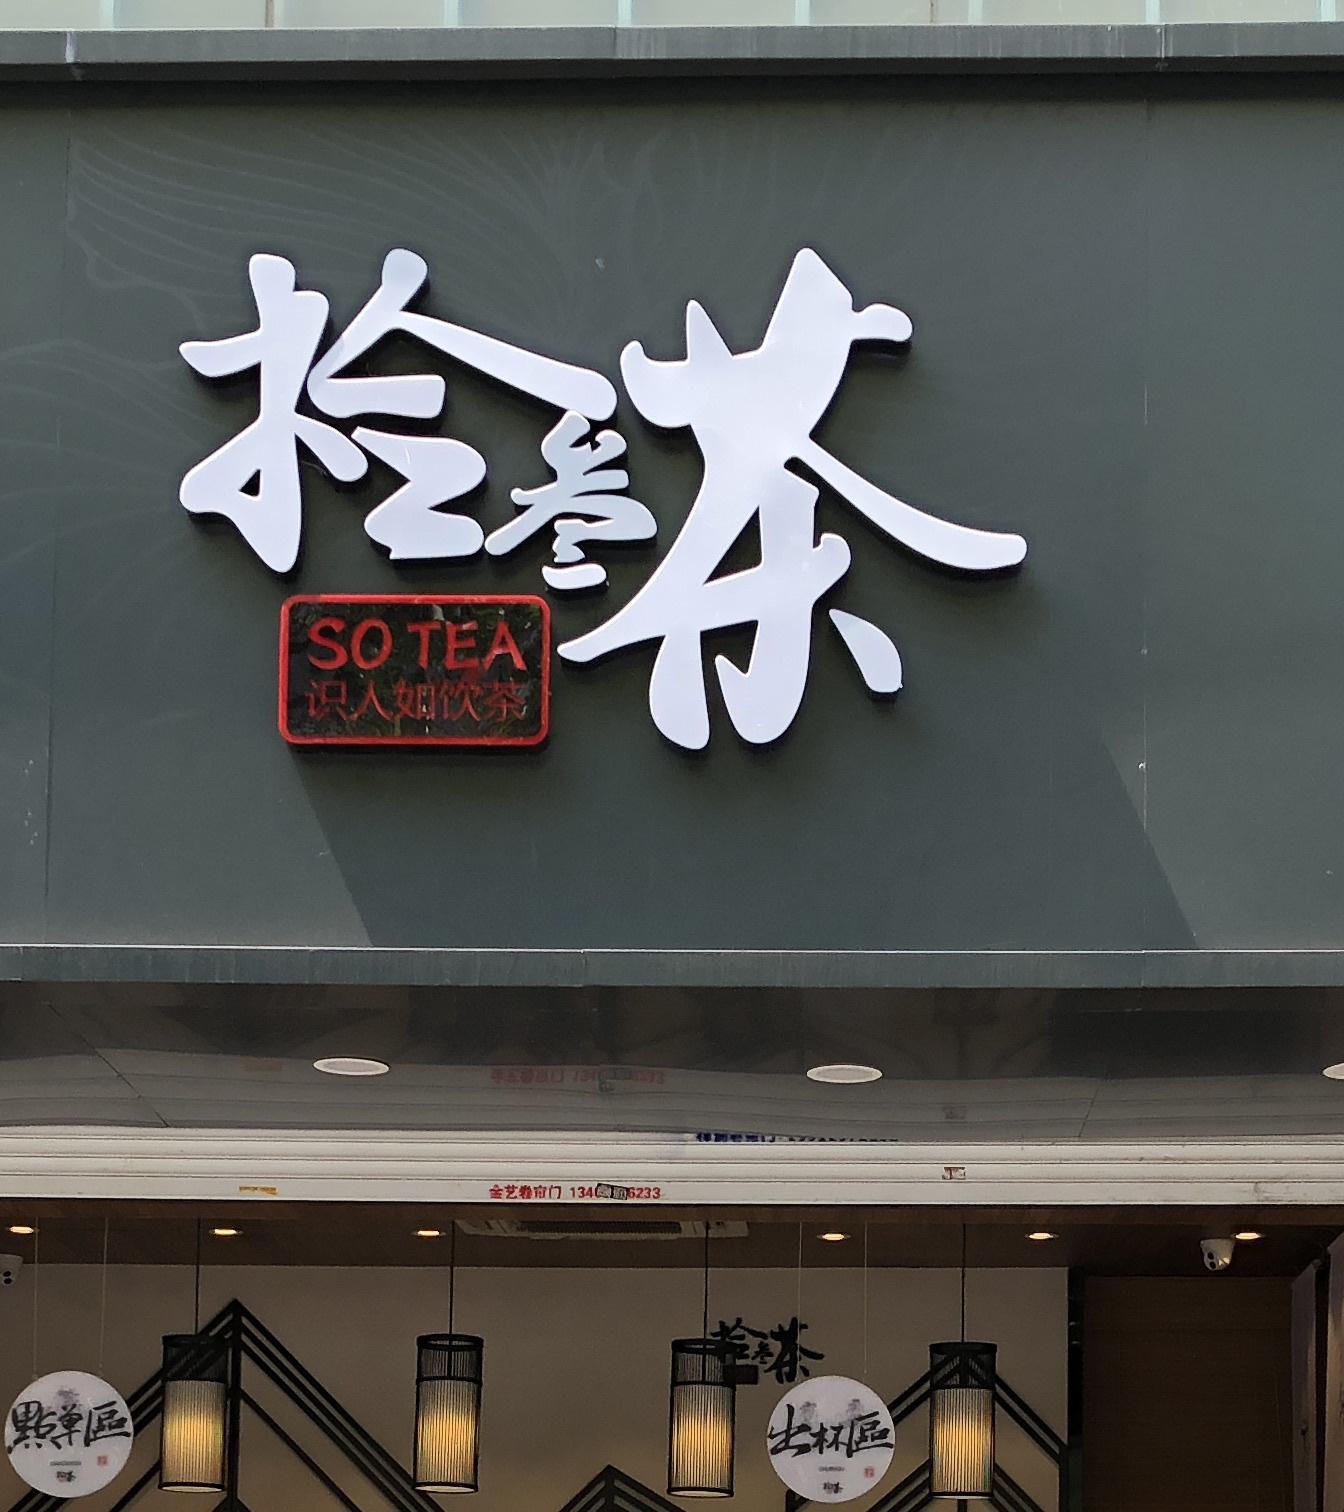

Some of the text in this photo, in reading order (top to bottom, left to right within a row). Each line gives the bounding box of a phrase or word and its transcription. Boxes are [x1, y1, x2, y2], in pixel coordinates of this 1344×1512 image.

[178, 247, 1028, 750] 拾叁茶
[308, 616, 528, 671] SO TEA
[305, 679, 528, 722] 识人如饮茶
